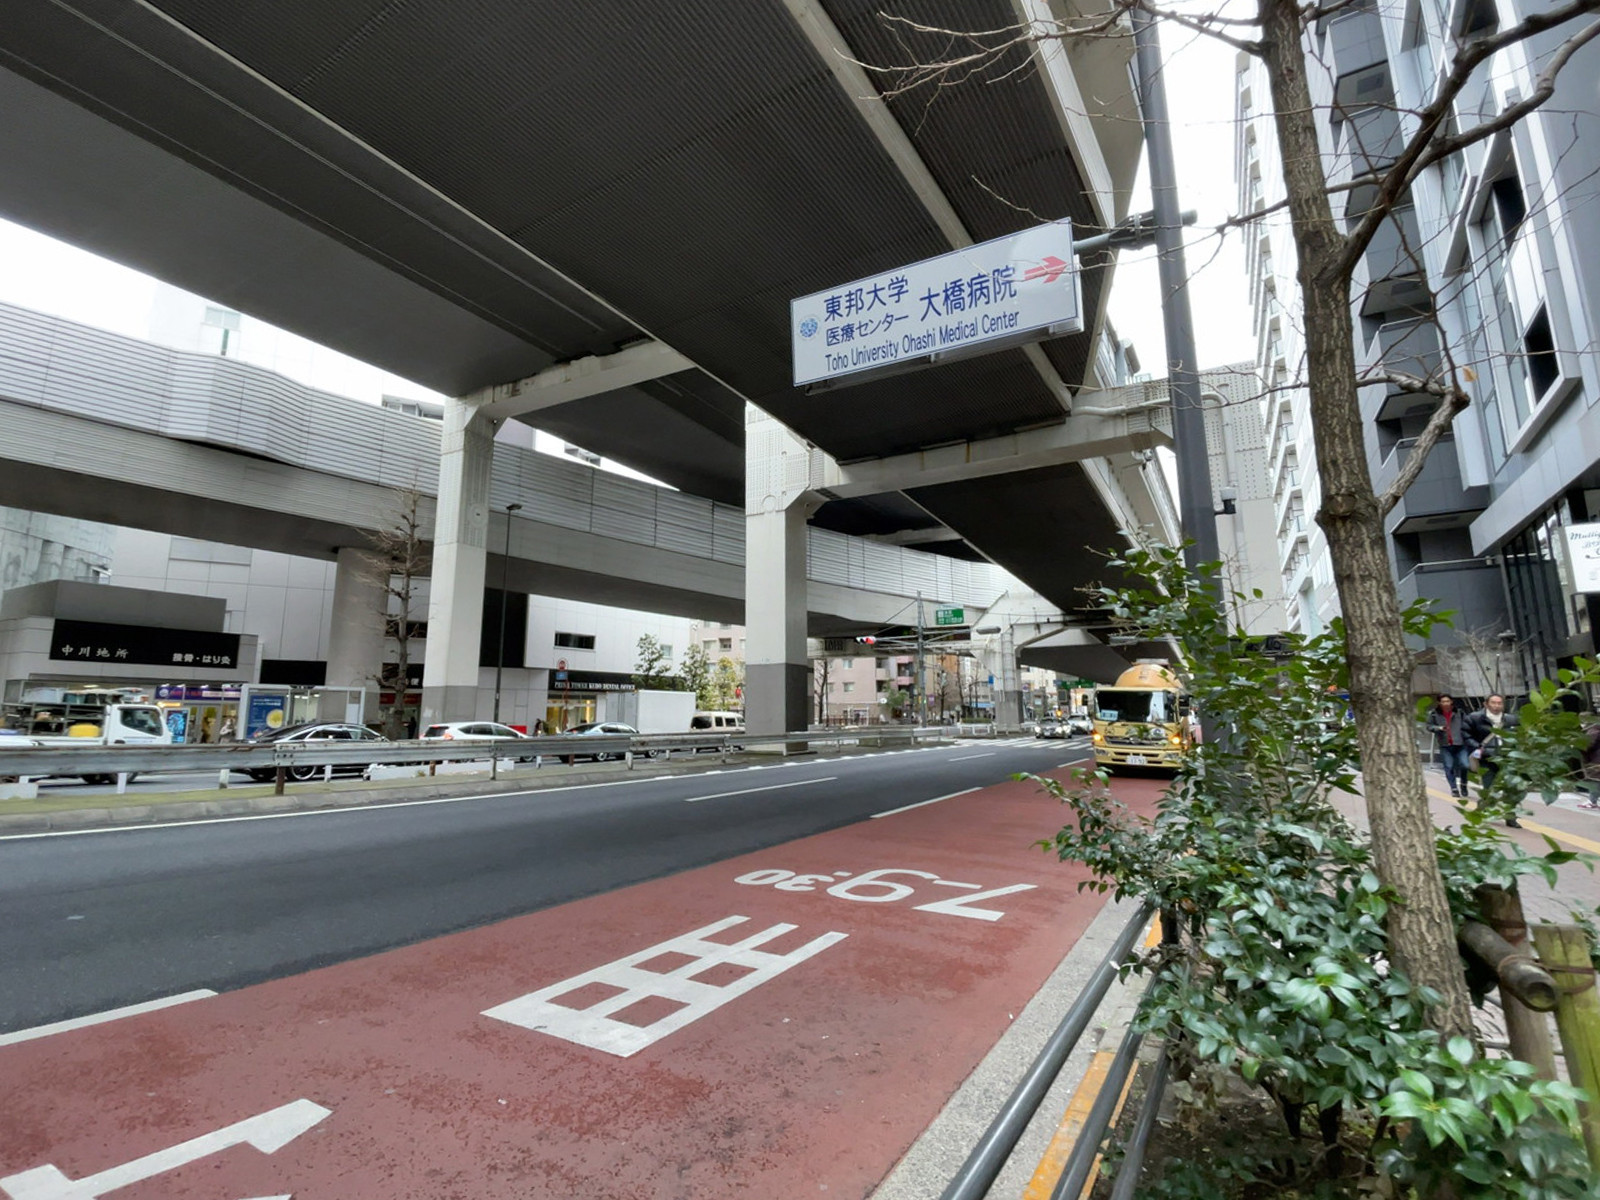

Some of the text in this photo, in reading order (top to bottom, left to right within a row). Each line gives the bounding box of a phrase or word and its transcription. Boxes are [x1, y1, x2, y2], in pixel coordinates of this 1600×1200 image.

[823, 274, 909, 322] 東邦大学
[919, 264, 1017, 322] 大橋病院
[825, 312, 909, 346] 医療センター
[825, 311, 1020, 372] Toho University Ohashi Medical Center
